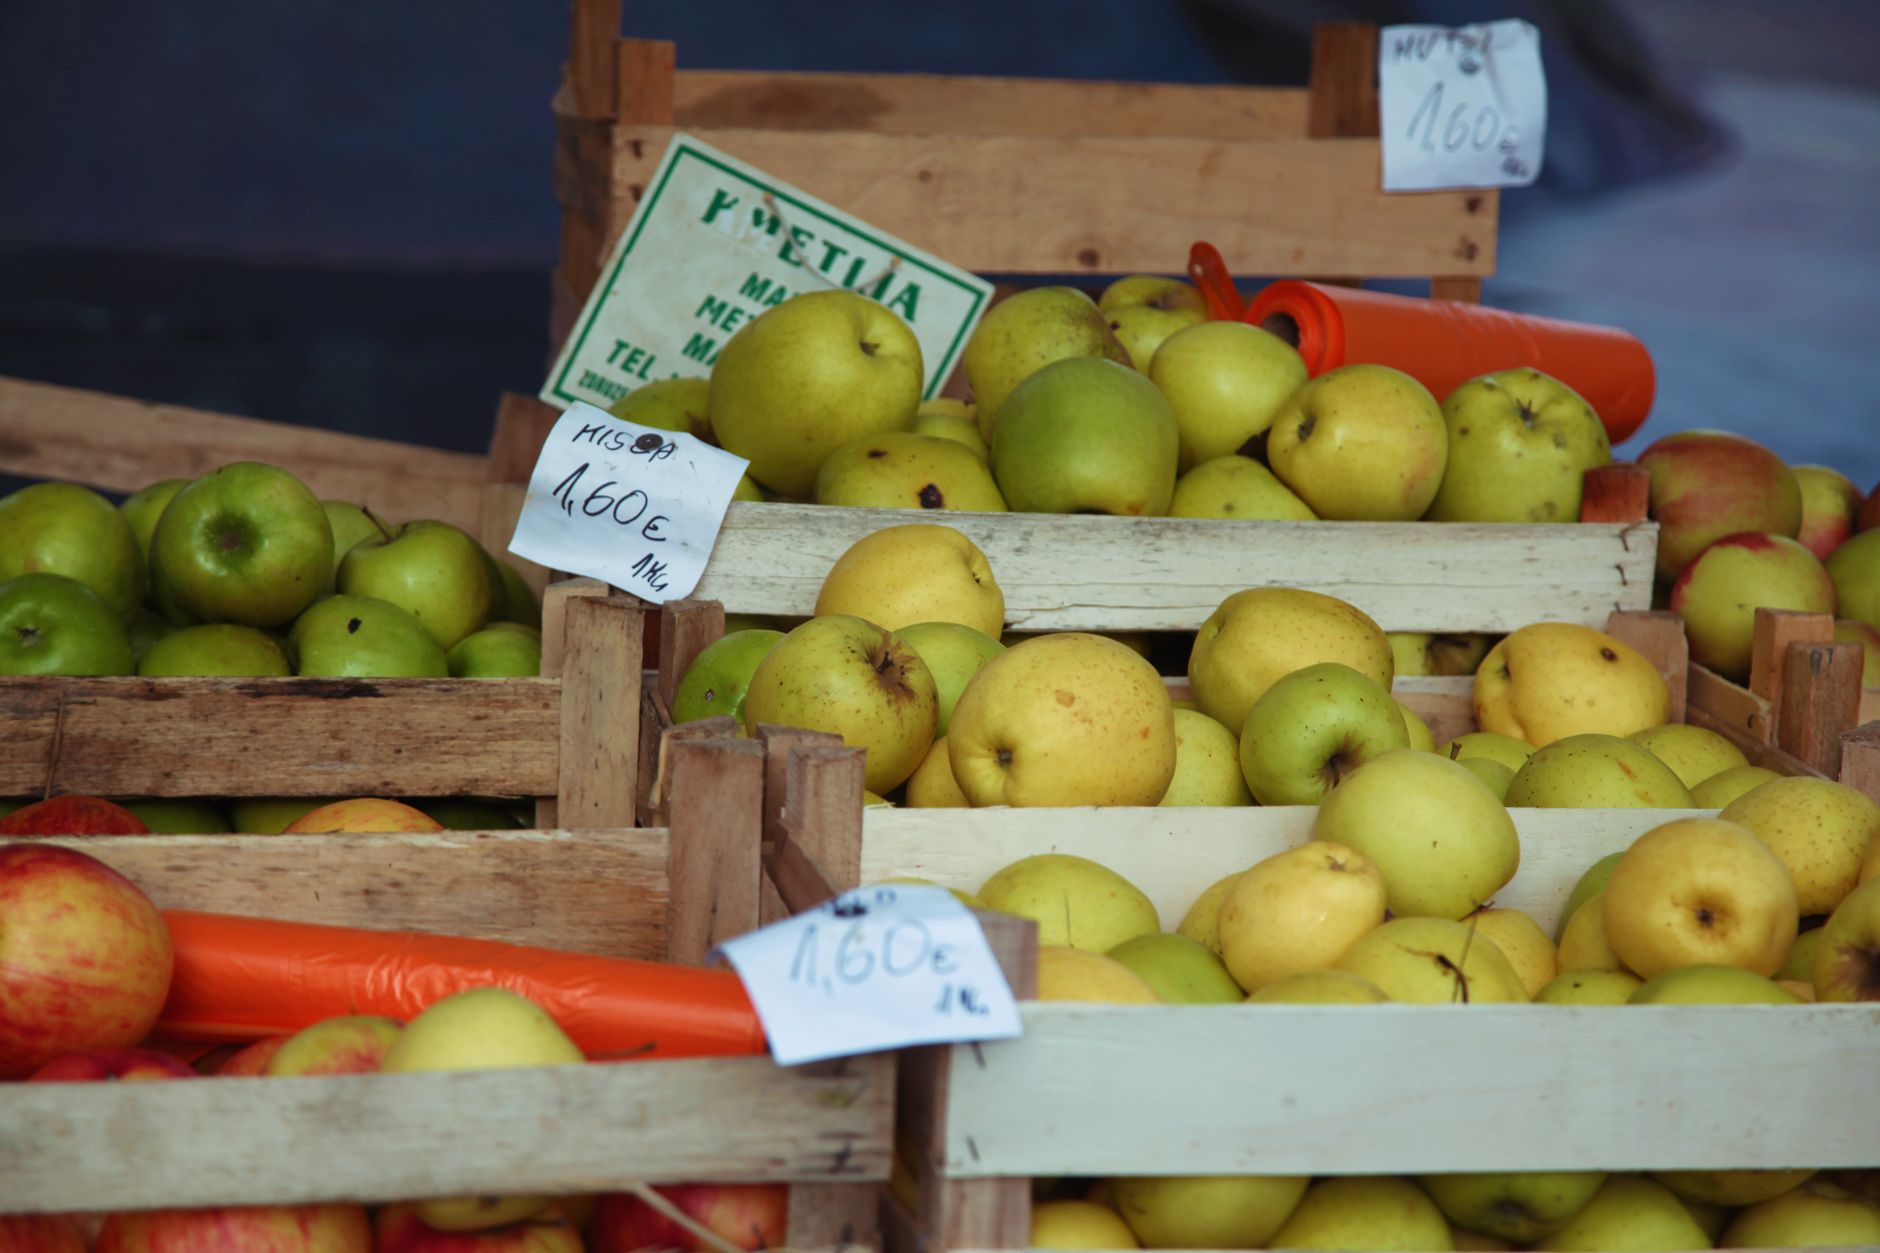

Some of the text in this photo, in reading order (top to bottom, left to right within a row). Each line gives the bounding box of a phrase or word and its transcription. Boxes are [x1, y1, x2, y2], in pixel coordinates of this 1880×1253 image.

[695, 294, 757, 333] ME
[738, 271, 800, 306] MA
[552, 462, 670, 541] 1,60€
[789, 917, 960, 1000] 1,60€
